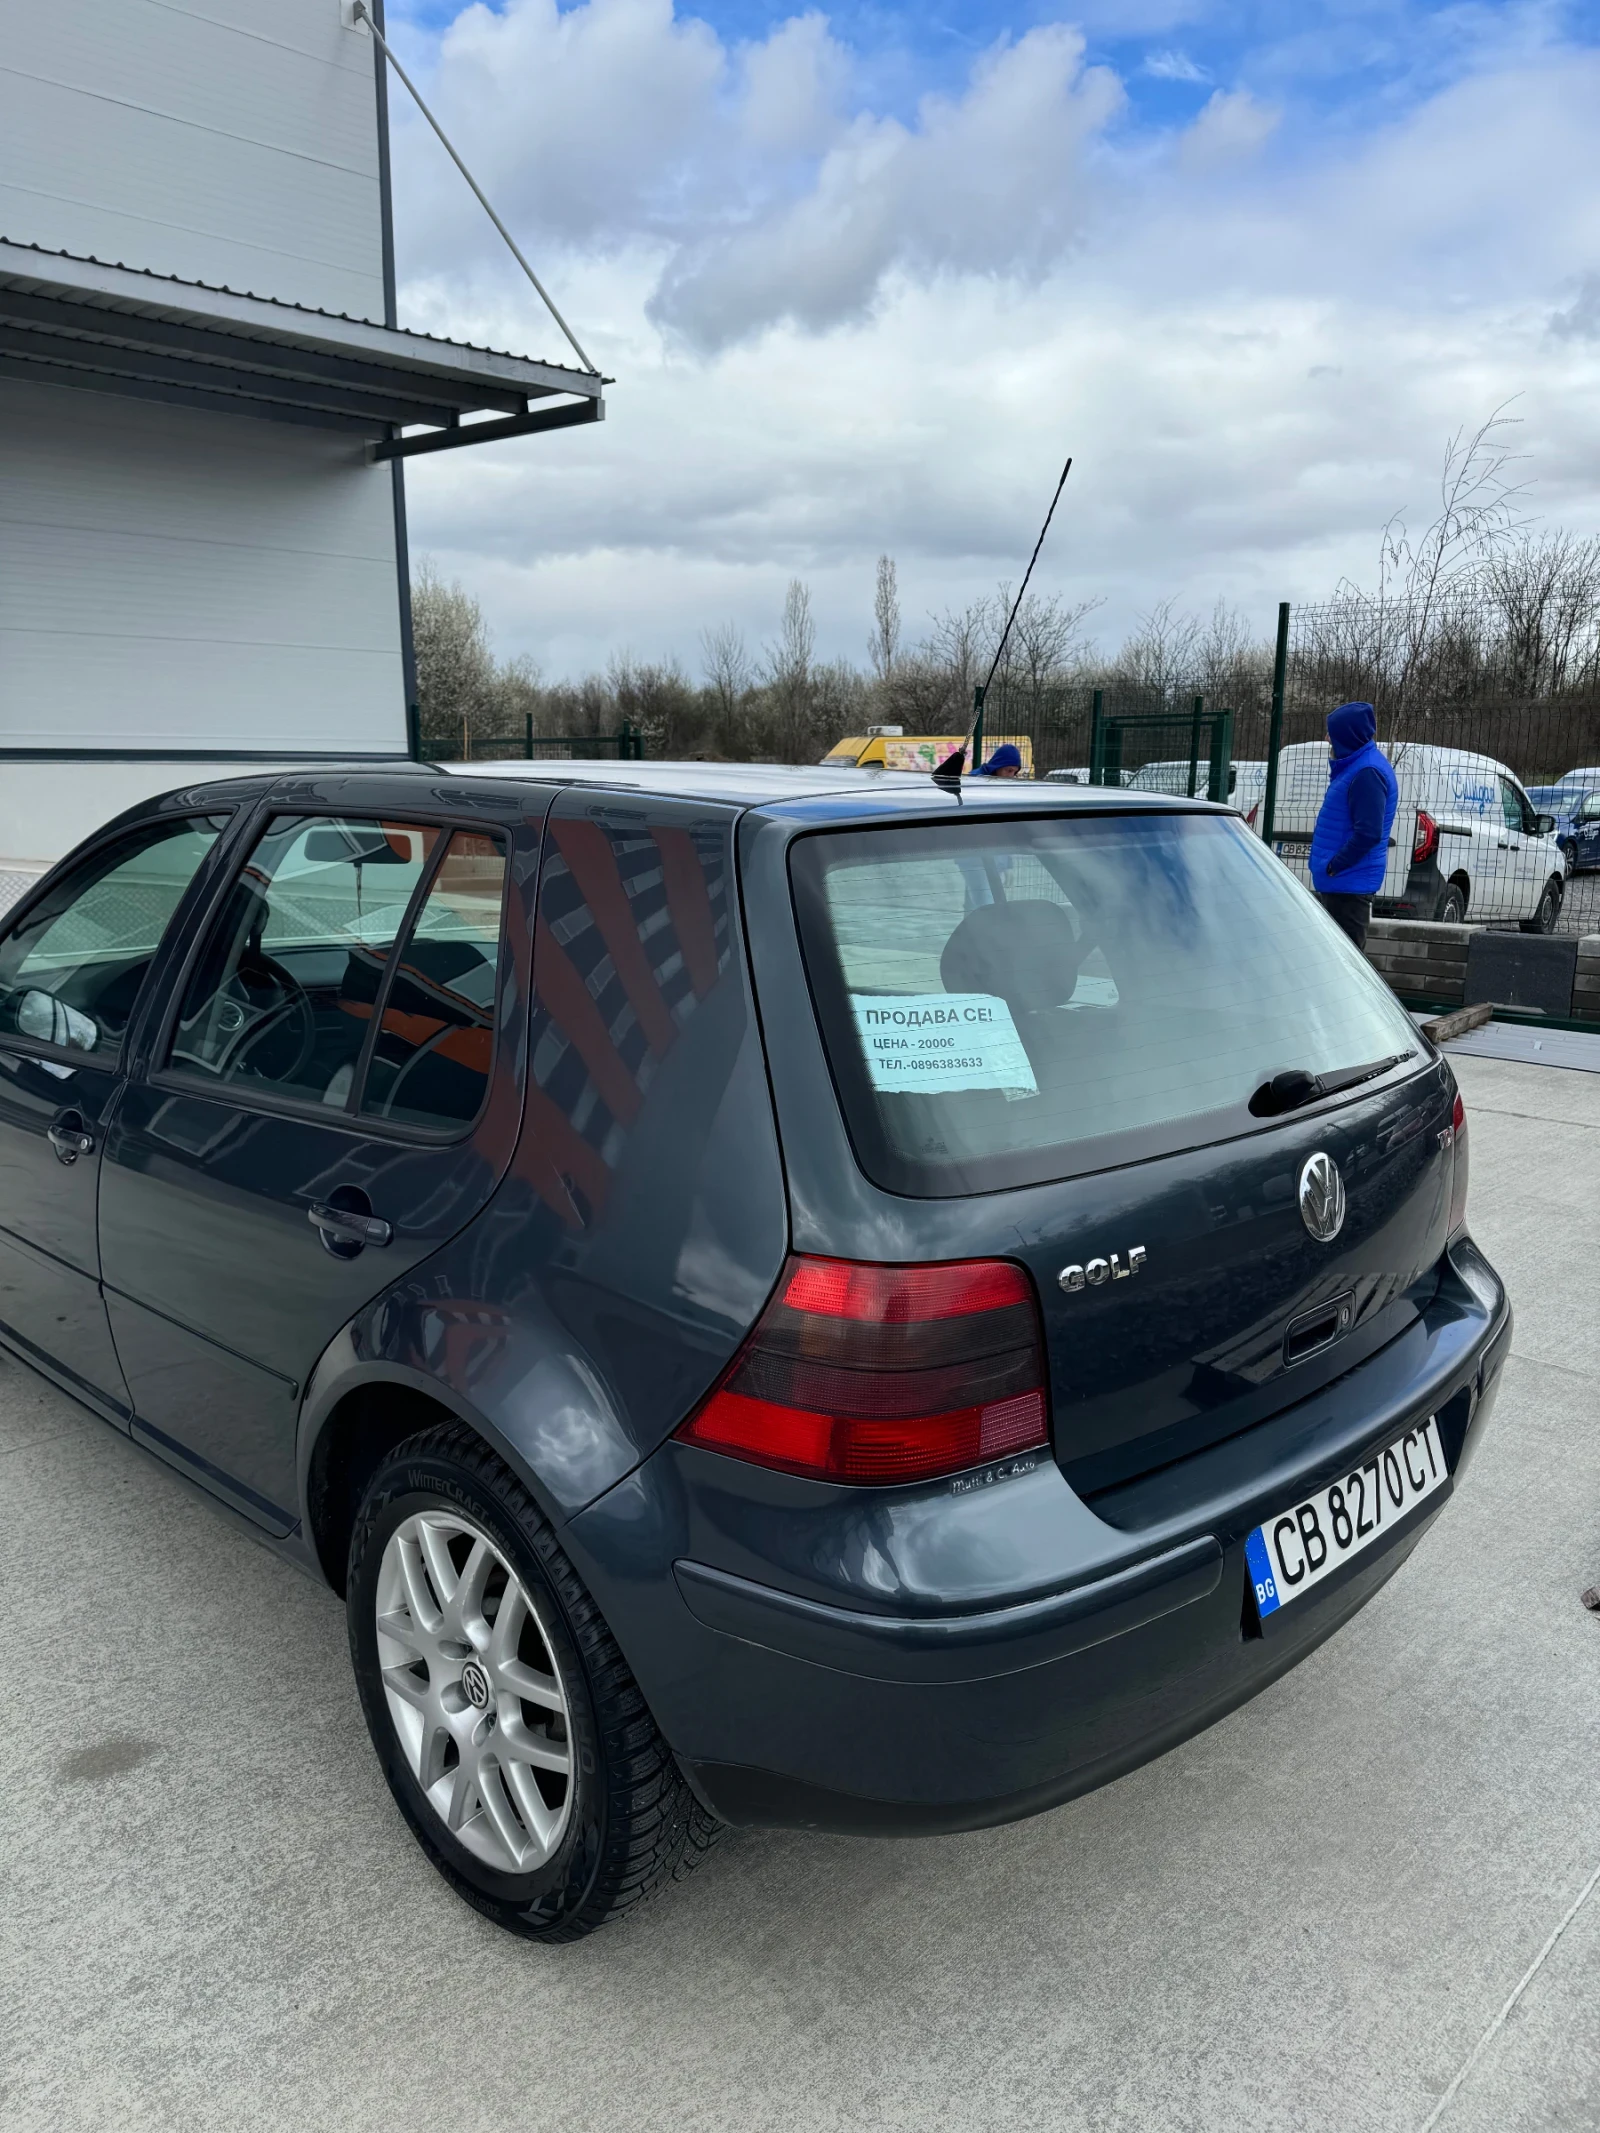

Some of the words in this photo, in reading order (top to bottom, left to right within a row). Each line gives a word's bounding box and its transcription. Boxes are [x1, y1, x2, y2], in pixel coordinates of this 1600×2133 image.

[866, 1008, 959, 1027] ПРОДАВА
[963, 1007, 993, 1022] СЕ!
[873, 1038, 909, 1050] ЦЕНА
[1058, 1245, 1148, 1293] GOLF
[1273, 1502, 1327, 1586] CB
[1328, 1448, 1404, 1549] 8270
[1402, 1418, 1438, 1492] CT
[1255, 1577, 1275, 1605] BG
